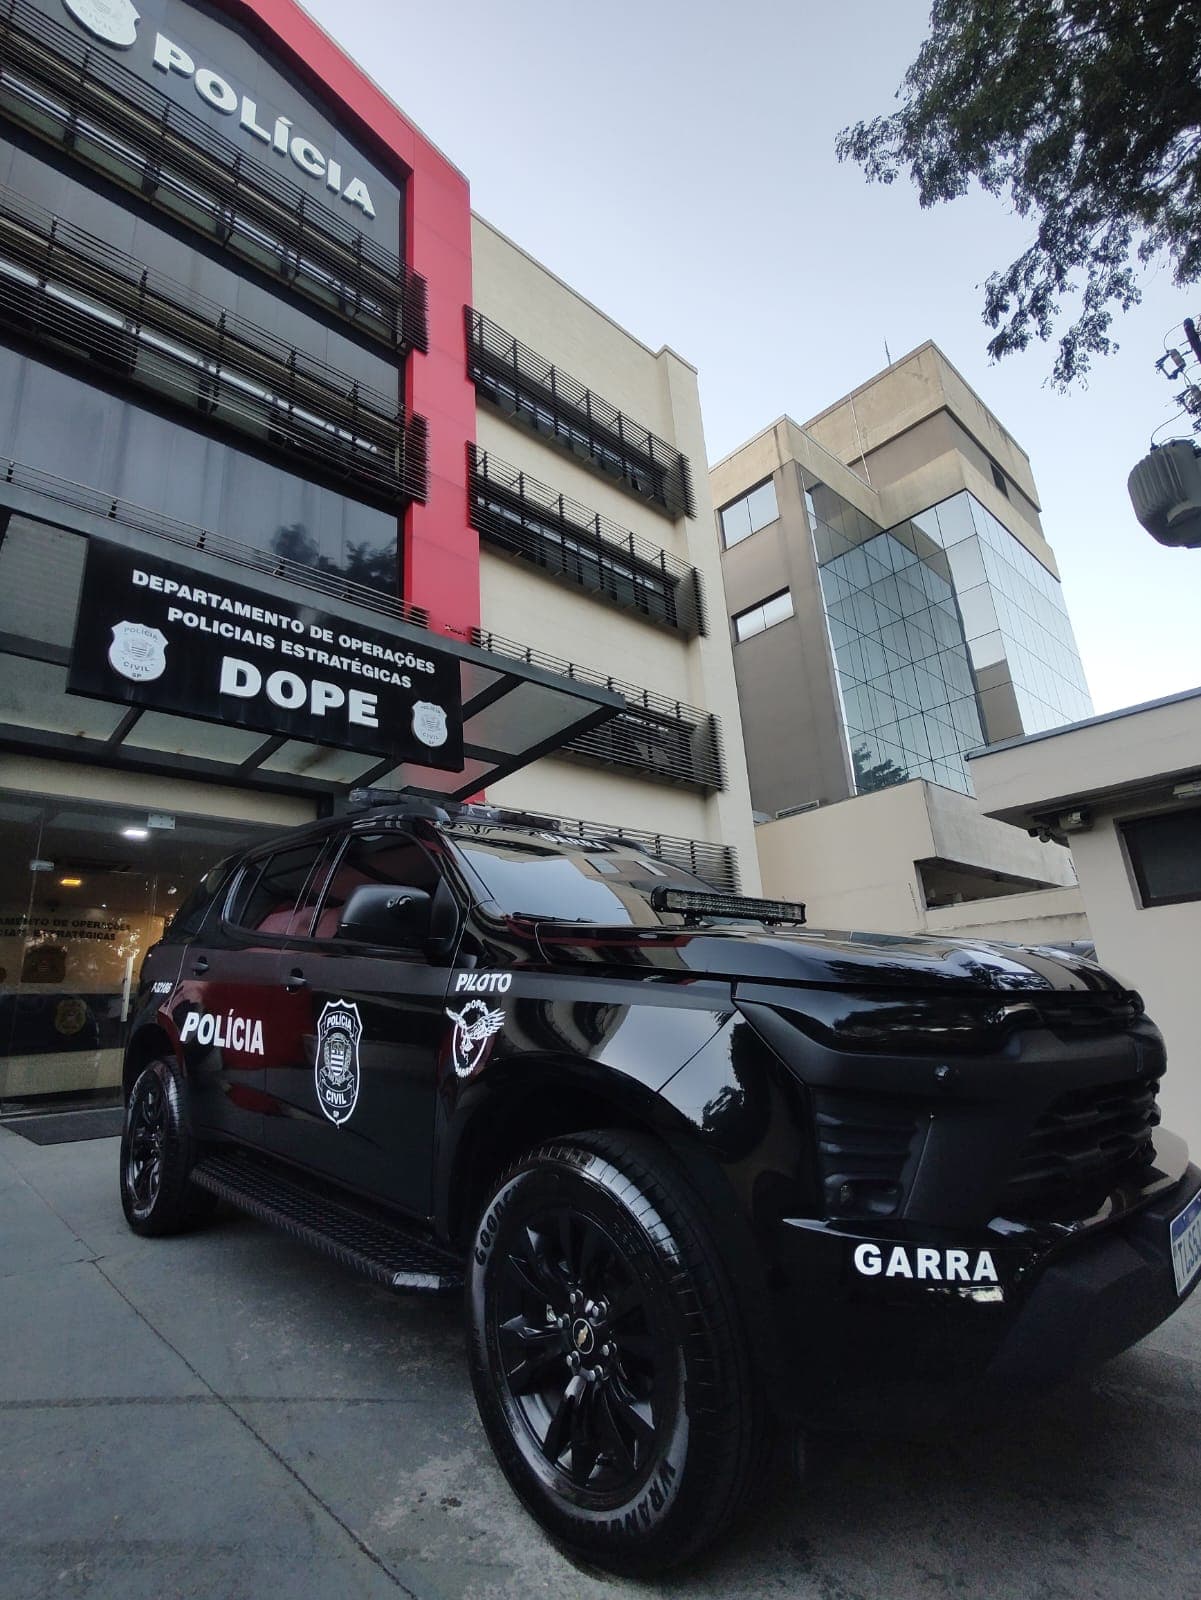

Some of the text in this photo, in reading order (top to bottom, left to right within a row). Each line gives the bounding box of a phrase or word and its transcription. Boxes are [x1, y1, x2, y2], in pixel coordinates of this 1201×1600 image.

[153, 32, 376, 220] POLÍCIA
[132, 569, 435, 674] DEPARTAMENTO DE OPERAÇÕES
[168, 607, 412, 688] POLICIAIS ESTRATÉGICAS
[220, 656, 379, 728] DOPE
[455, 973, 513, 993] PILOTO
[180, 1008, 265, 1056] POLÍCIA
[325, 1089, 347, 1105] CIVIL
[854, 1243, 999, 1281] GARRA
